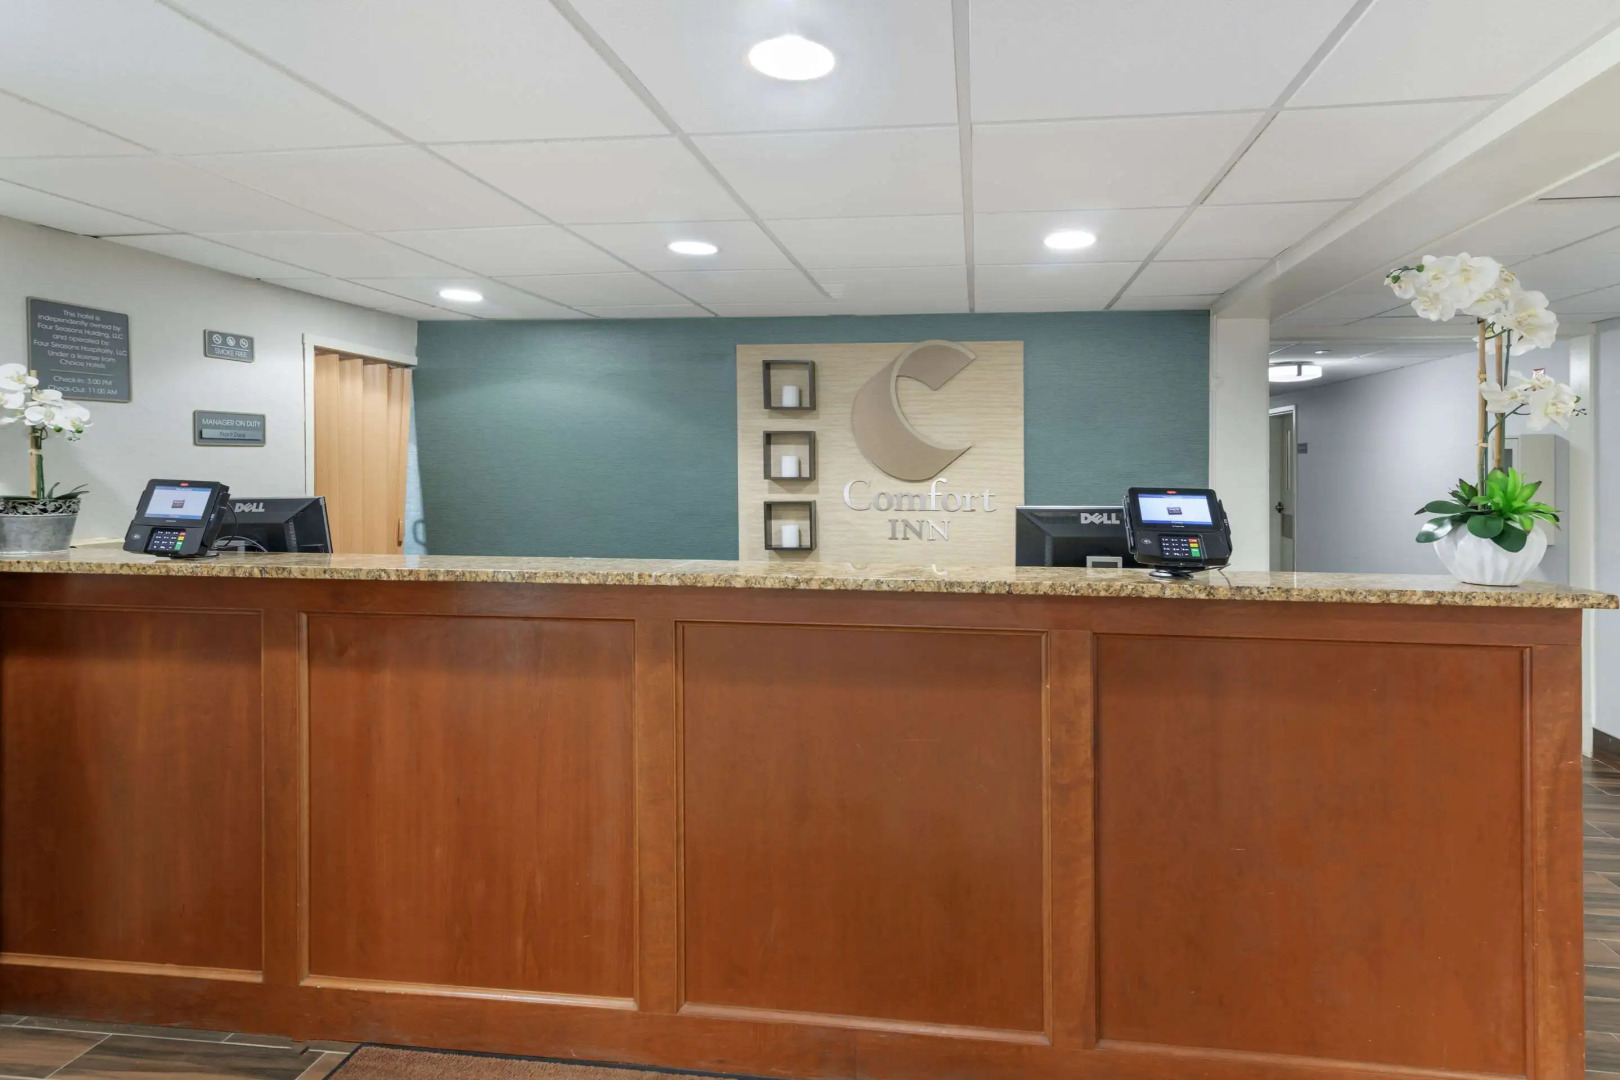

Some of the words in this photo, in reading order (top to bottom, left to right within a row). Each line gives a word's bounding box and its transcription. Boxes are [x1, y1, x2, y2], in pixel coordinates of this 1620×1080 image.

[77, 312, 94, 320] hotel
[38, 314, 88, 327] independently
[89, 322, 112, 330] owned
[54, 324, 83, 334] Seasons
[50, 341, 80, 350] Seasons
[68, 336, 99, 345] operated
[214, 348, 234, 356] SMOKE
[59, 359, 85, 367] Choice
[843, 478, 998, 513] Comfort
[234, 502, 265, 513] DELL
[1080, 512, 1120, 524] DELL
[888, 519, 950, 541] INN
